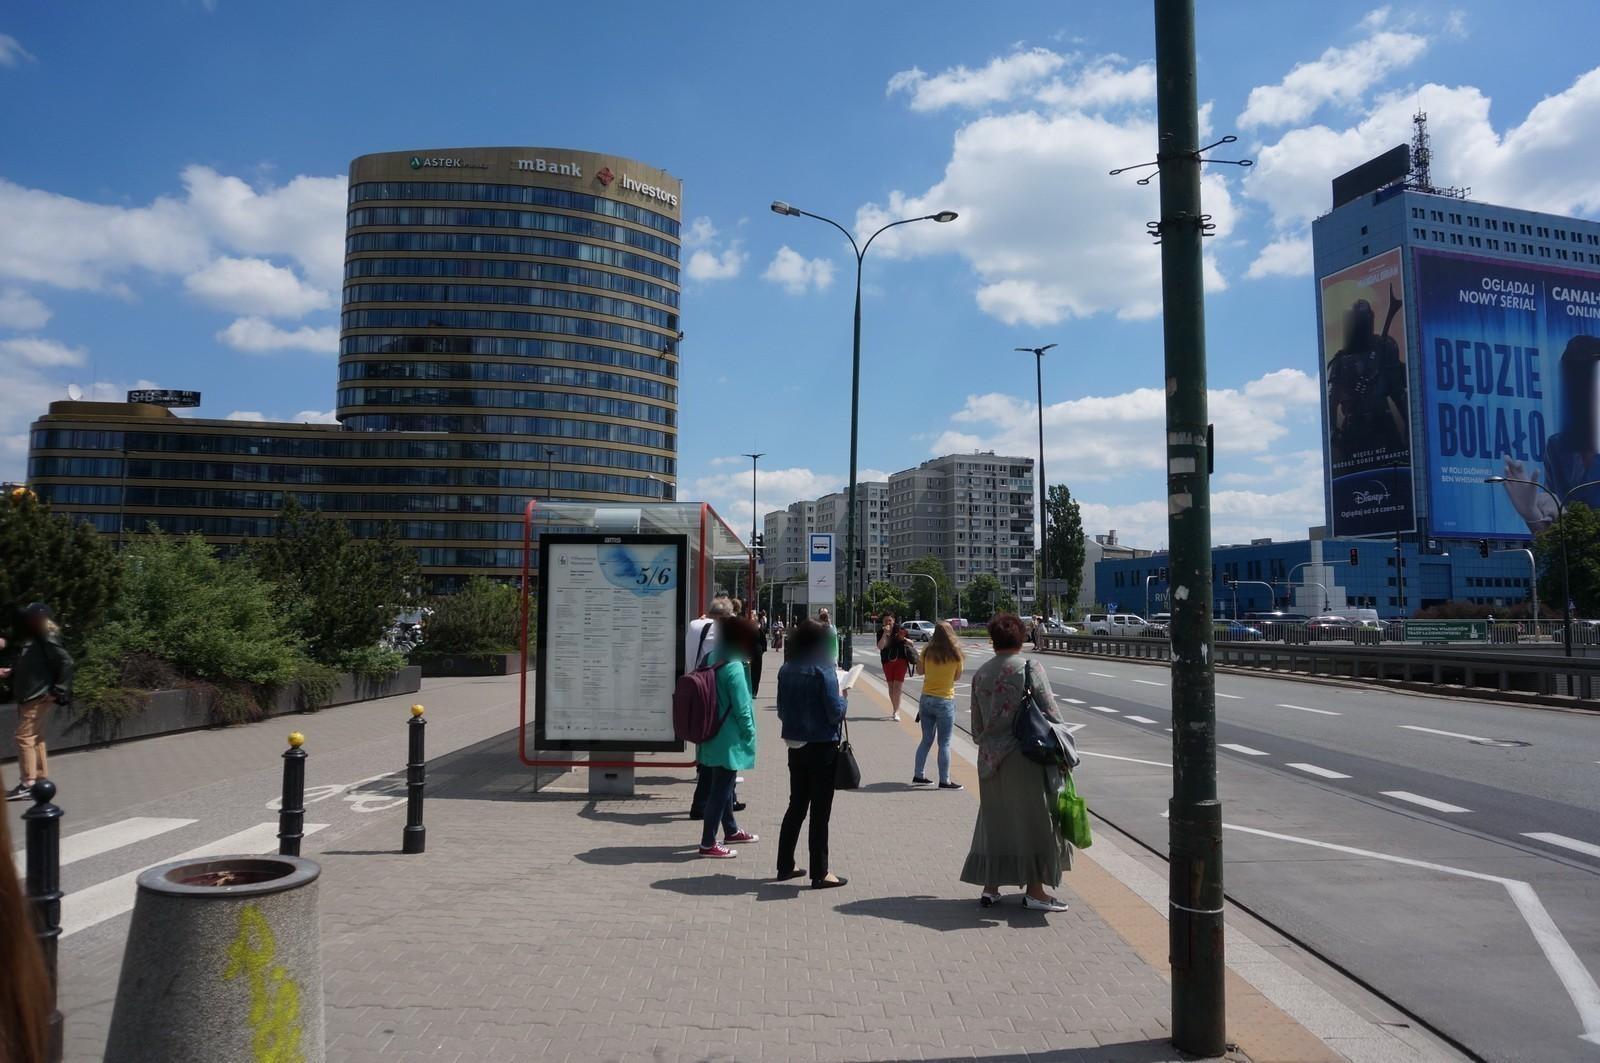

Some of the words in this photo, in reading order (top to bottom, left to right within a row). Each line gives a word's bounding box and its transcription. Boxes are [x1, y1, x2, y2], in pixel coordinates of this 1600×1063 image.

[518, 158, 582, 178] mBank
[622, 173, 678, 206] Investors
[1481, 277, 1535, 296] OGLĄDAJ
[1459, 289, 1498, 306] NOWY
[1500, 295, 1536, 311] SERIAL
[1566, 304, 1600, 319] ONLIN
[1434, 337, 1543, 401] BĘDZIE
[1438, 402, 1546, 463] BOLAŁO
[636, 566, 671, 586] 5/6
